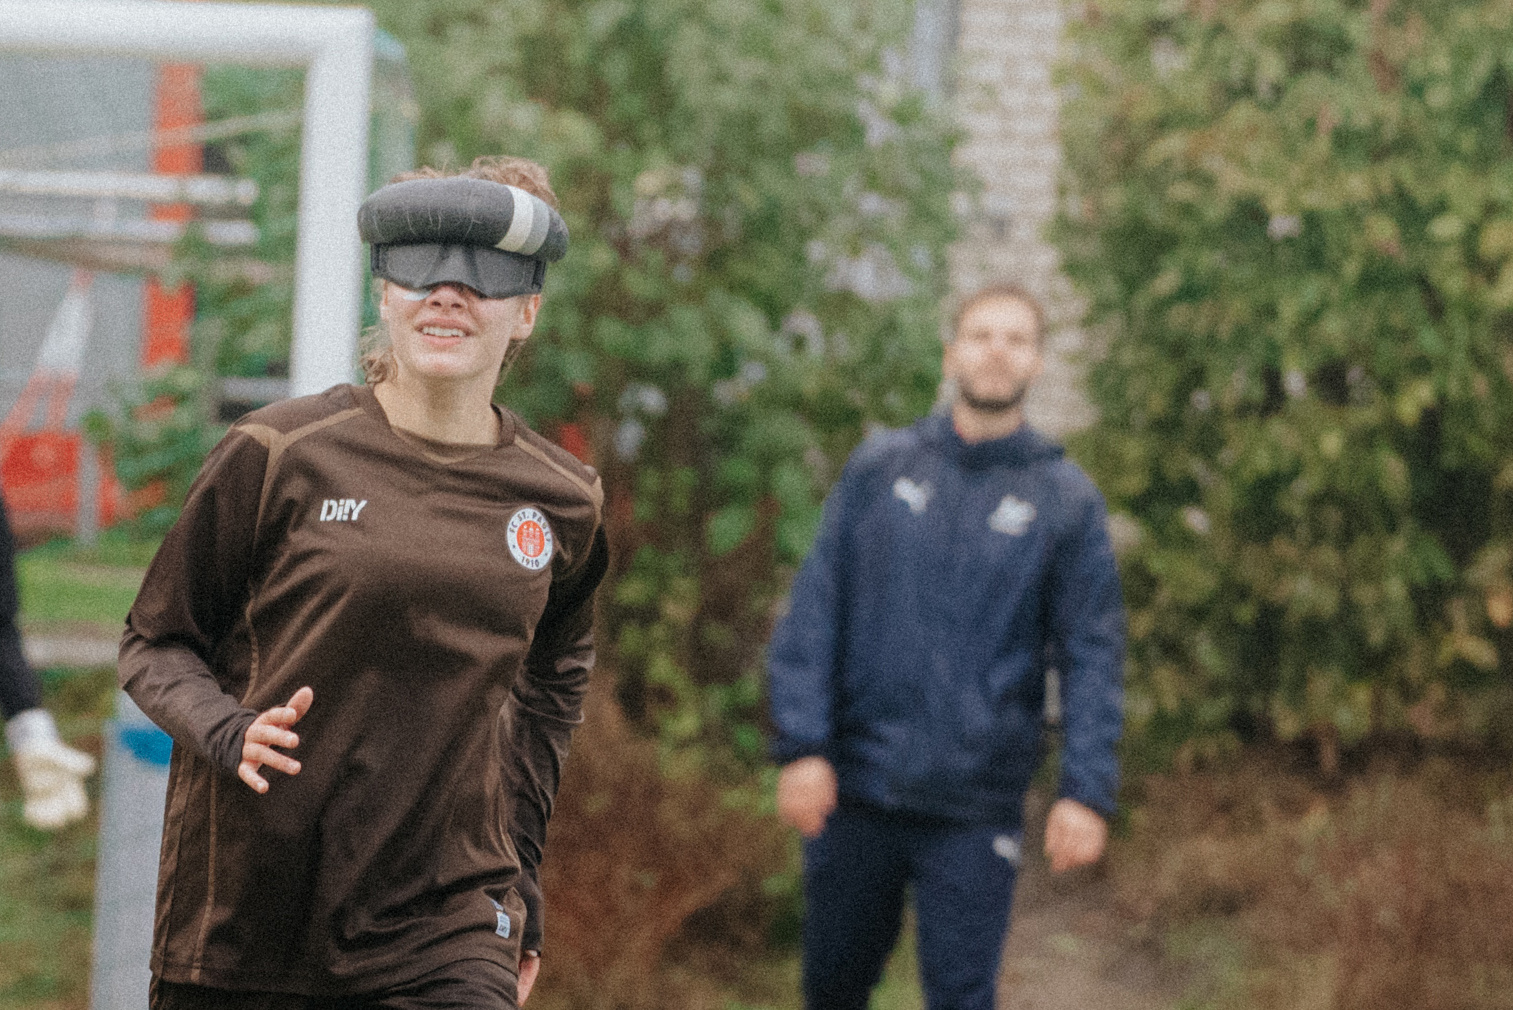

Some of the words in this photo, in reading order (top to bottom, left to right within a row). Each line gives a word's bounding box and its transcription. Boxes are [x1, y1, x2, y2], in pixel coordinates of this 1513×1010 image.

[517, 511, 530, 522] ST.
[532, 511, 551, 542] PAULI
[521, 556, 540, 568] 1910
